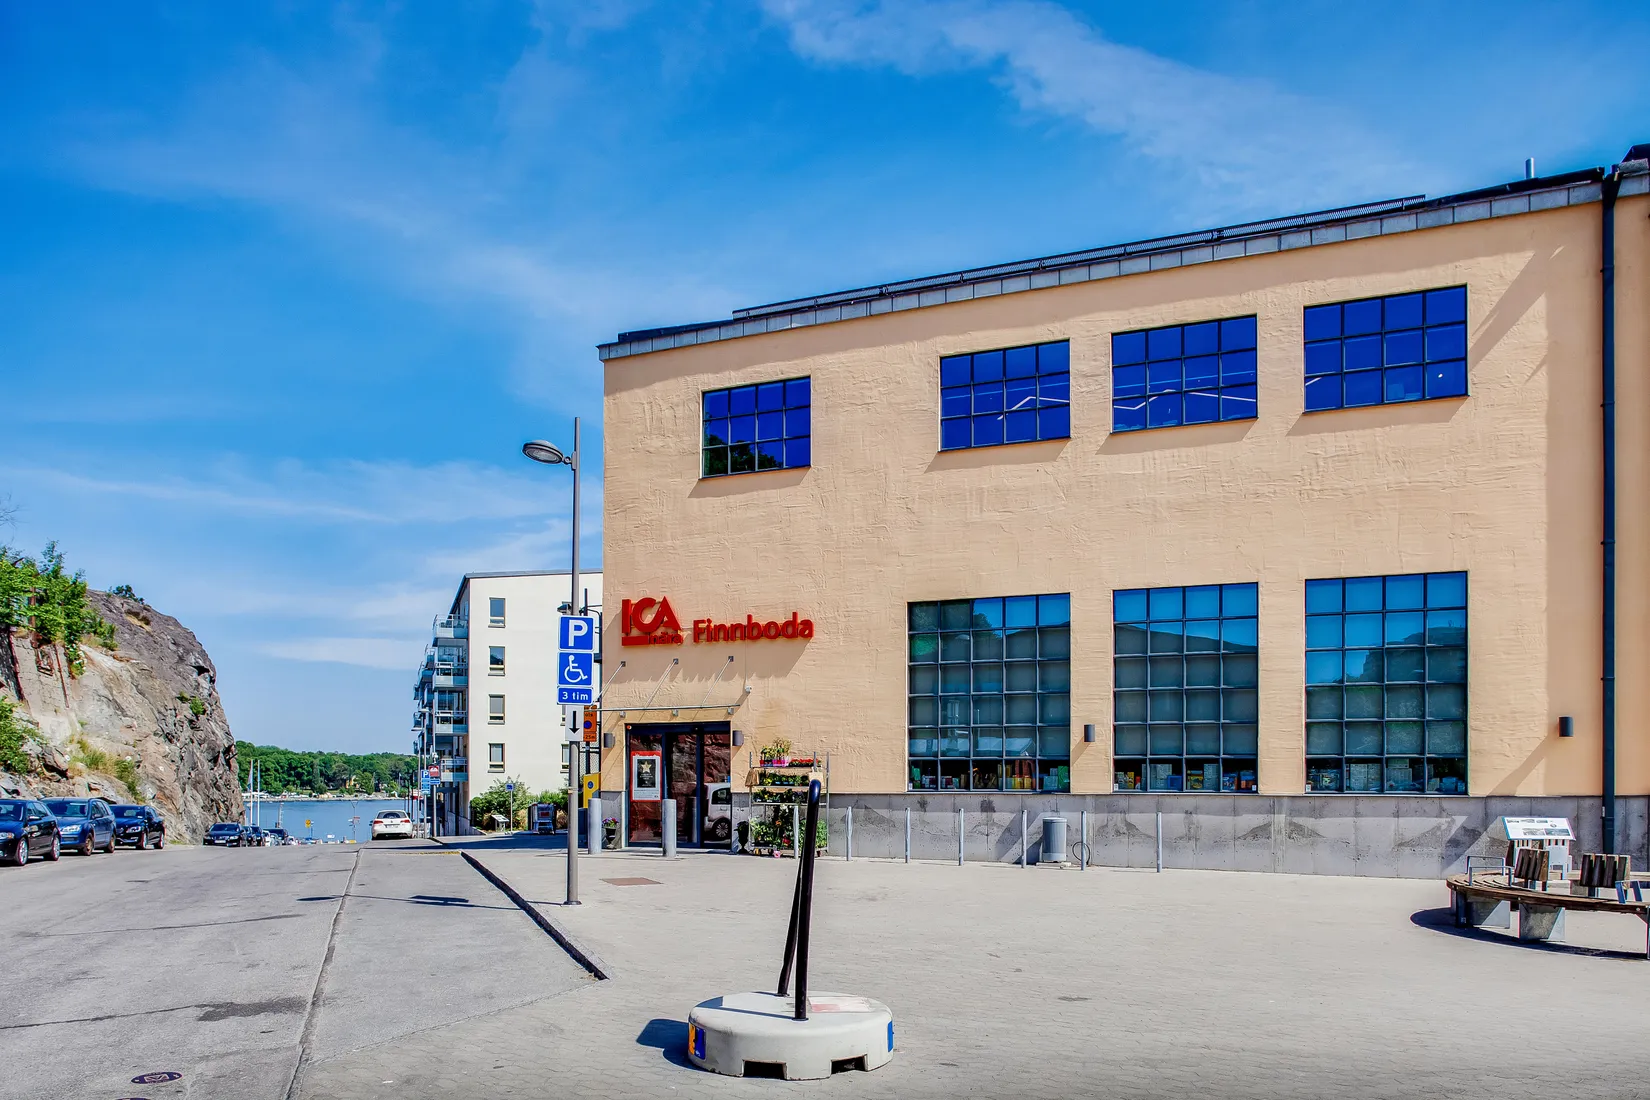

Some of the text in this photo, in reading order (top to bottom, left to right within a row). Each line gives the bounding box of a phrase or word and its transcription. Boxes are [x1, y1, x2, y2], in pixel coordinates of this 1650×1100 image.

[622, 596, 682, 634] ICA
[693, 612, 814, 643] Finnboda
[568, 619, 588, 647] P
[650, 632, 683, 645] nära
[562, 692, 588, 700] 3 tim
